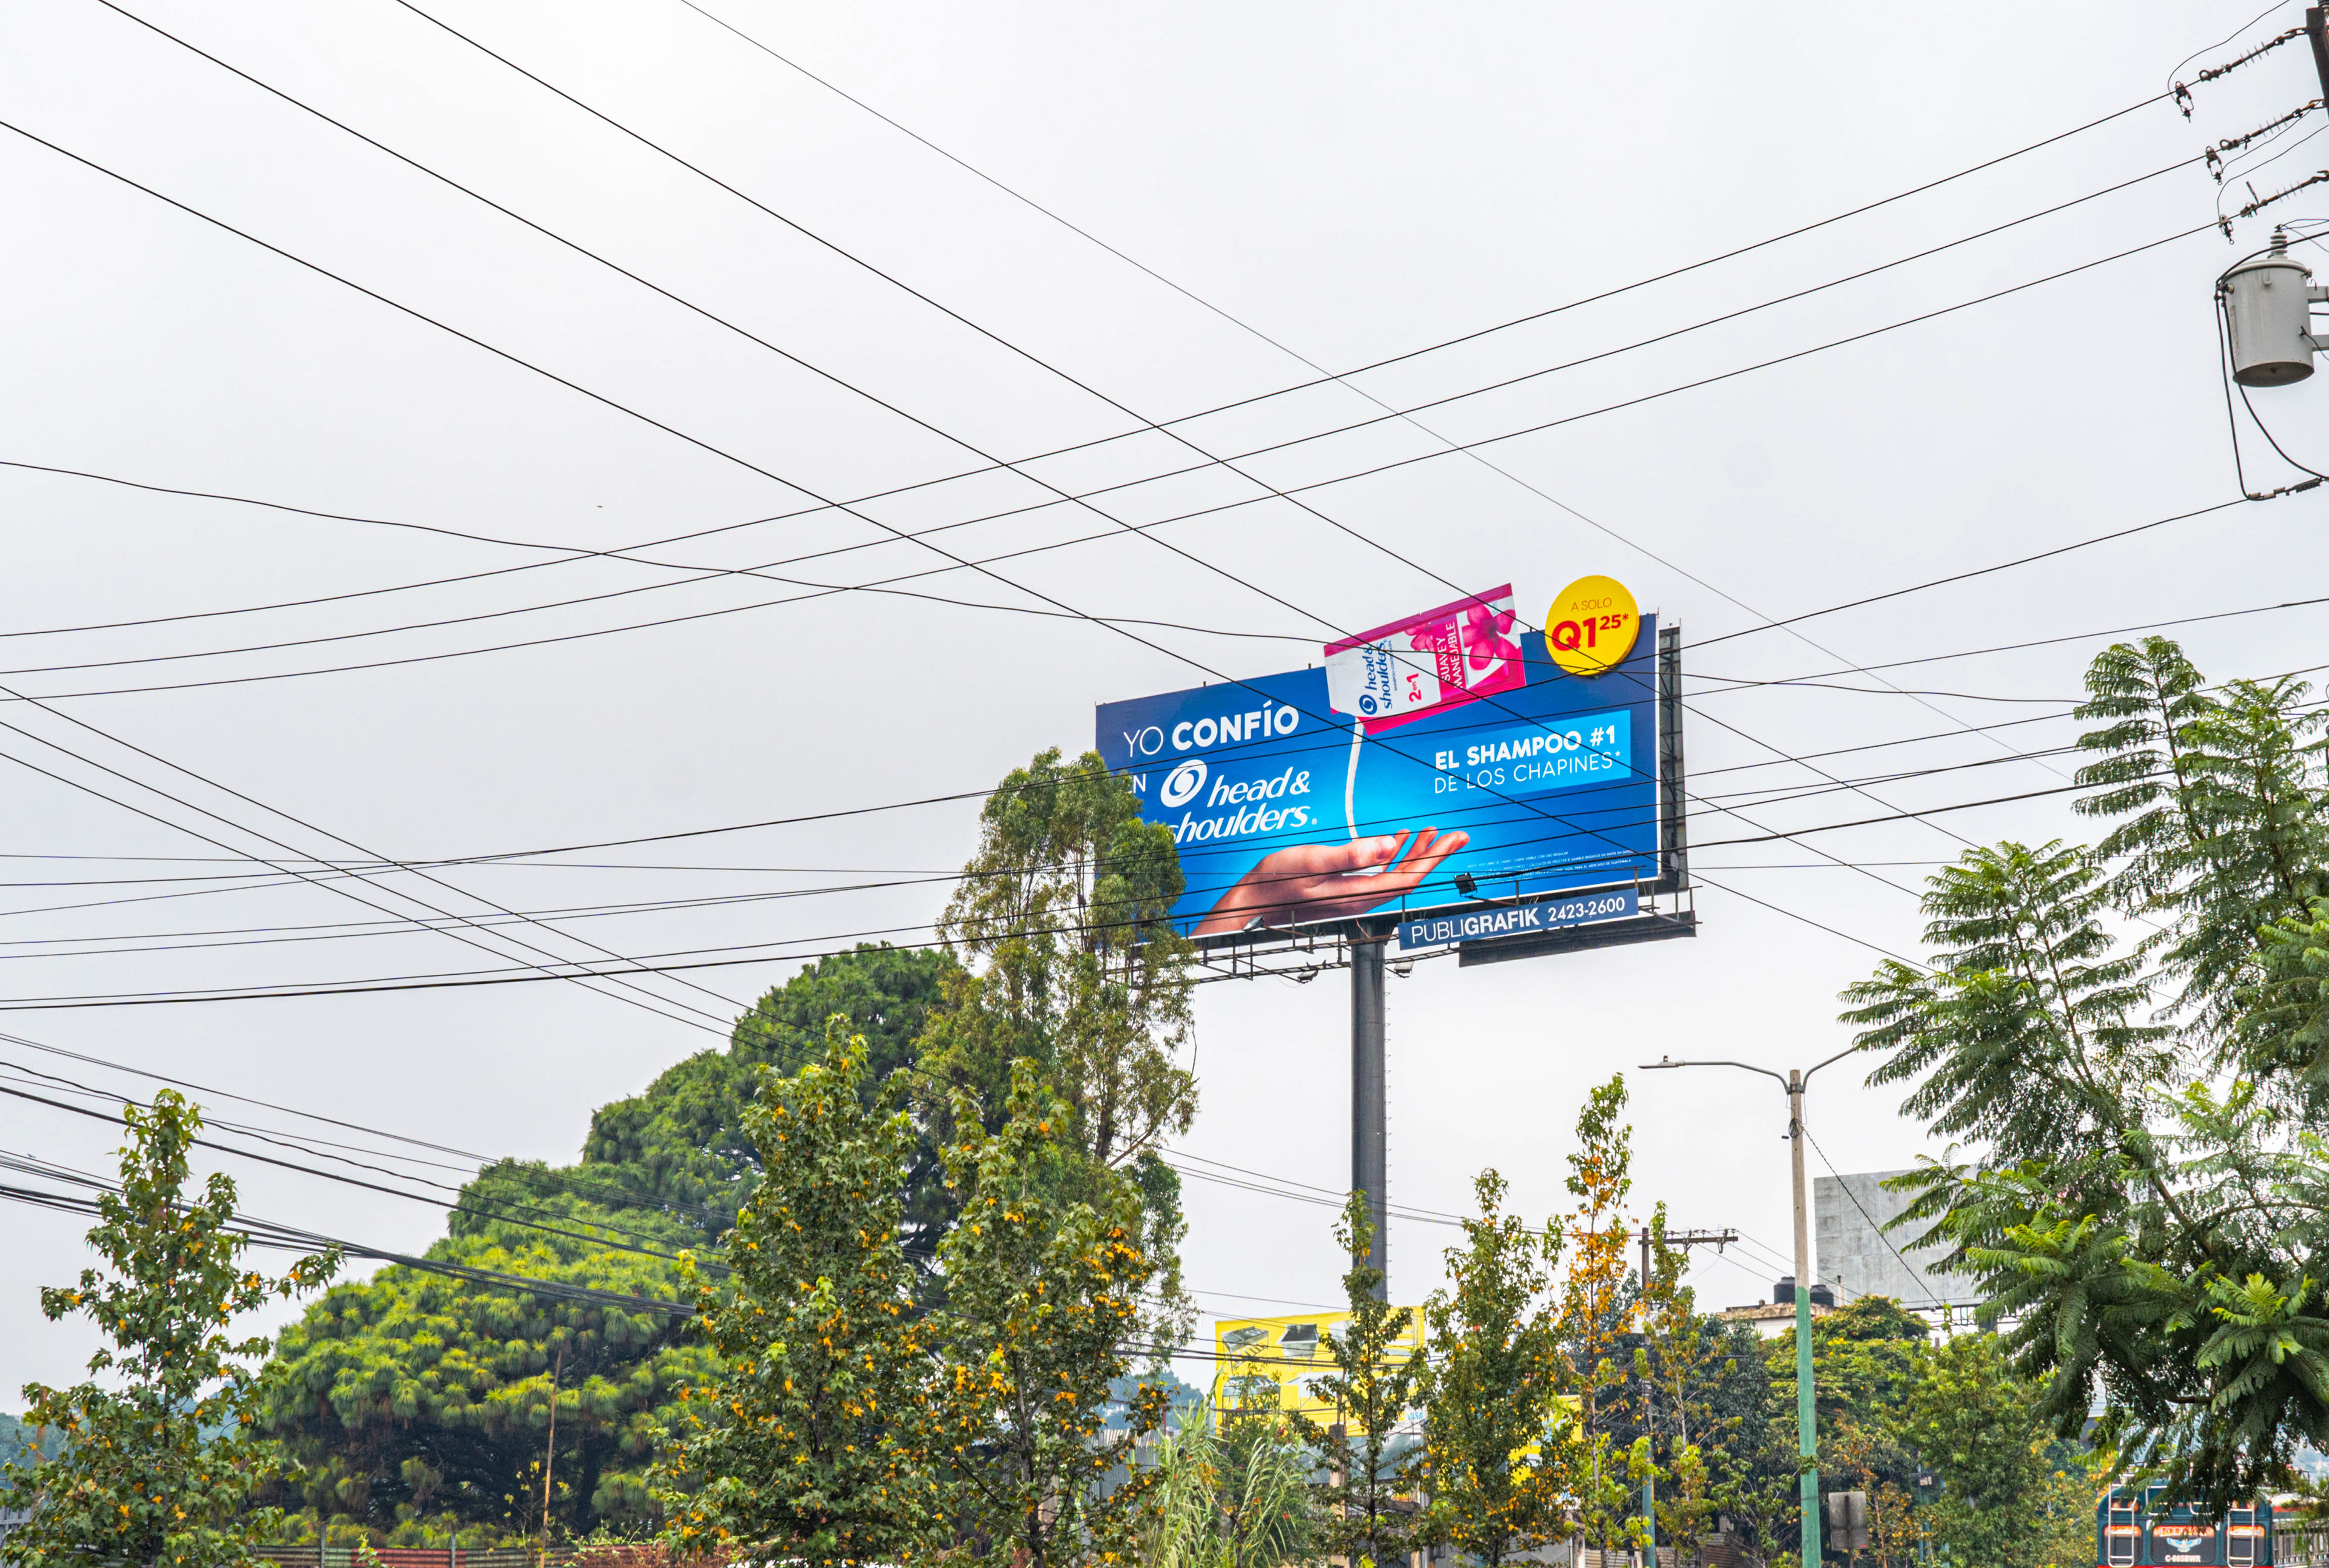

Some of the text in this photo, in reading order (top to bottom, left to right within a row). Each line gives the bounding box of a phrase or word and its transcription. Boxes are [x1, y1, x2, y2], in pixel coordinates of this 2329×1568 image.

[1571, 597, 1612, 612] A SOLO
[1445, 621, 1464, 688] MANEJABLE
[1123, 700, 1299, 757] YO CONFÍO
[1436, 725, 1615, 770] EL SHAMPOO #1
[1125, 773, 1146, 793] N
[1435, 775, 1457, 793] DE
[1467, 768, 1505, 789] LOS
[1411, 897, 1625, 944] PUBLIGRAFIK 2423-2600
